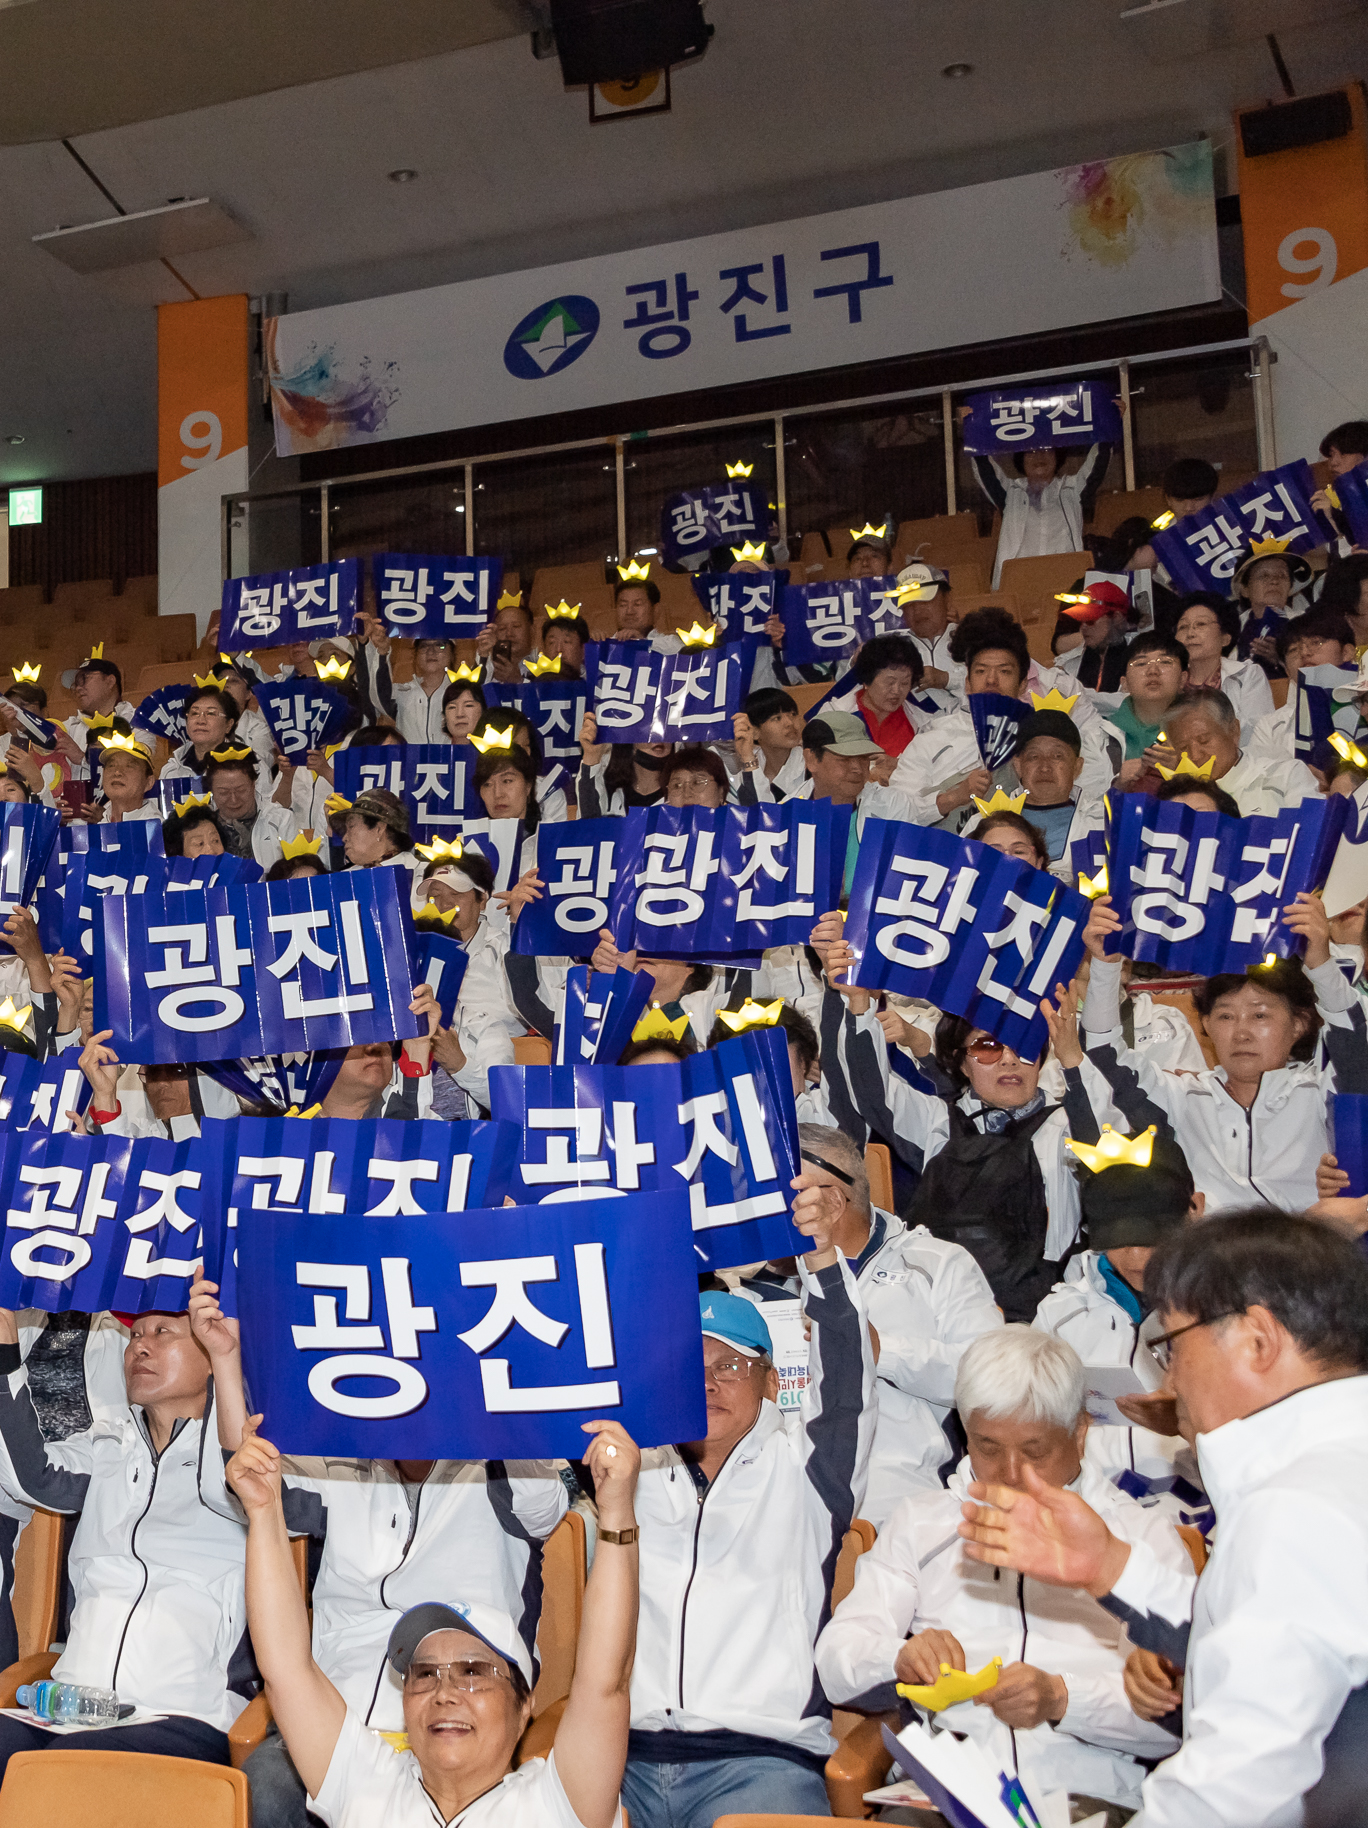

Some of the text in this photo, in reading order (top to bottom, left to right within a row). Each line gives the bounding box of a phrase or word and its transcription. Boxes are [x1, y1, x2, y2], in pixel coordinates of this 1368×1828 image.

[623, 241, 894, 360] 광진구
[1278, 227, 1338, 299] 9
[179, 410, 222, 470] 9
[990, 390, 1095, 442] 광진
[670, 491, 756, 545] 광진
[1185, 482, 1310, 580] 광진
[238, 572, 339, 637] 광진
[381, 567, 490, 624] 광진
[593, 658, 729, 728] 광진
[549, 840, 616, 933] 광
[636, 822, 814, 928] 광진
[1130, 823, 1300, 944] 광진
[144, 899, 374, 1033] 광진
[876, 856, 1077, 1020] 광진
[521, 1073, 787, 1232] 광진
[291, 1242, 620, 1418] 광진
